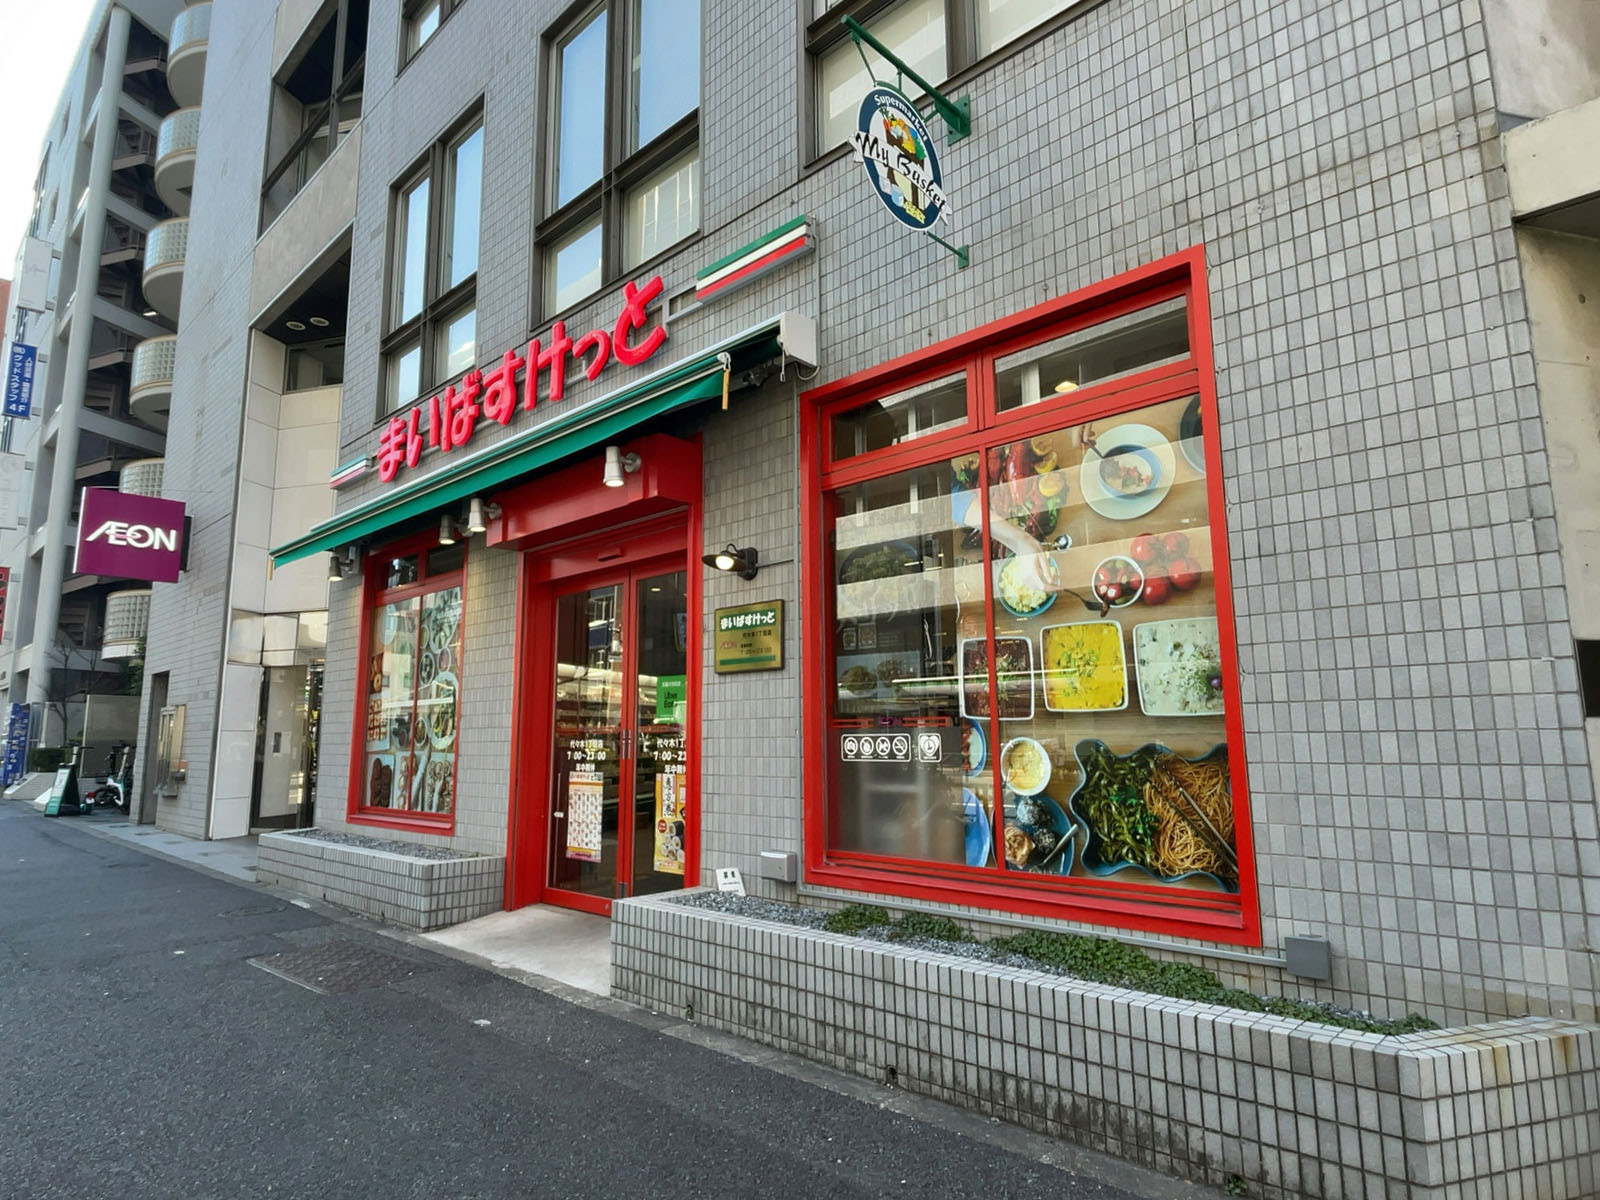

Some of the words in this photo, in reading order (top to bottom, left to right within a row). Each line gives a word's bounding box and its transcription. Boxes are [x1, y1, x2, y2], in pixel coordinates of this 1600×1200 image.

[874, 94, 928, 141] Supermarket
[855, 132, 889, 168] My
[377, 275, 667, 483] まいばすけっと
[720, 611, 776, 630] まいばすけっと
